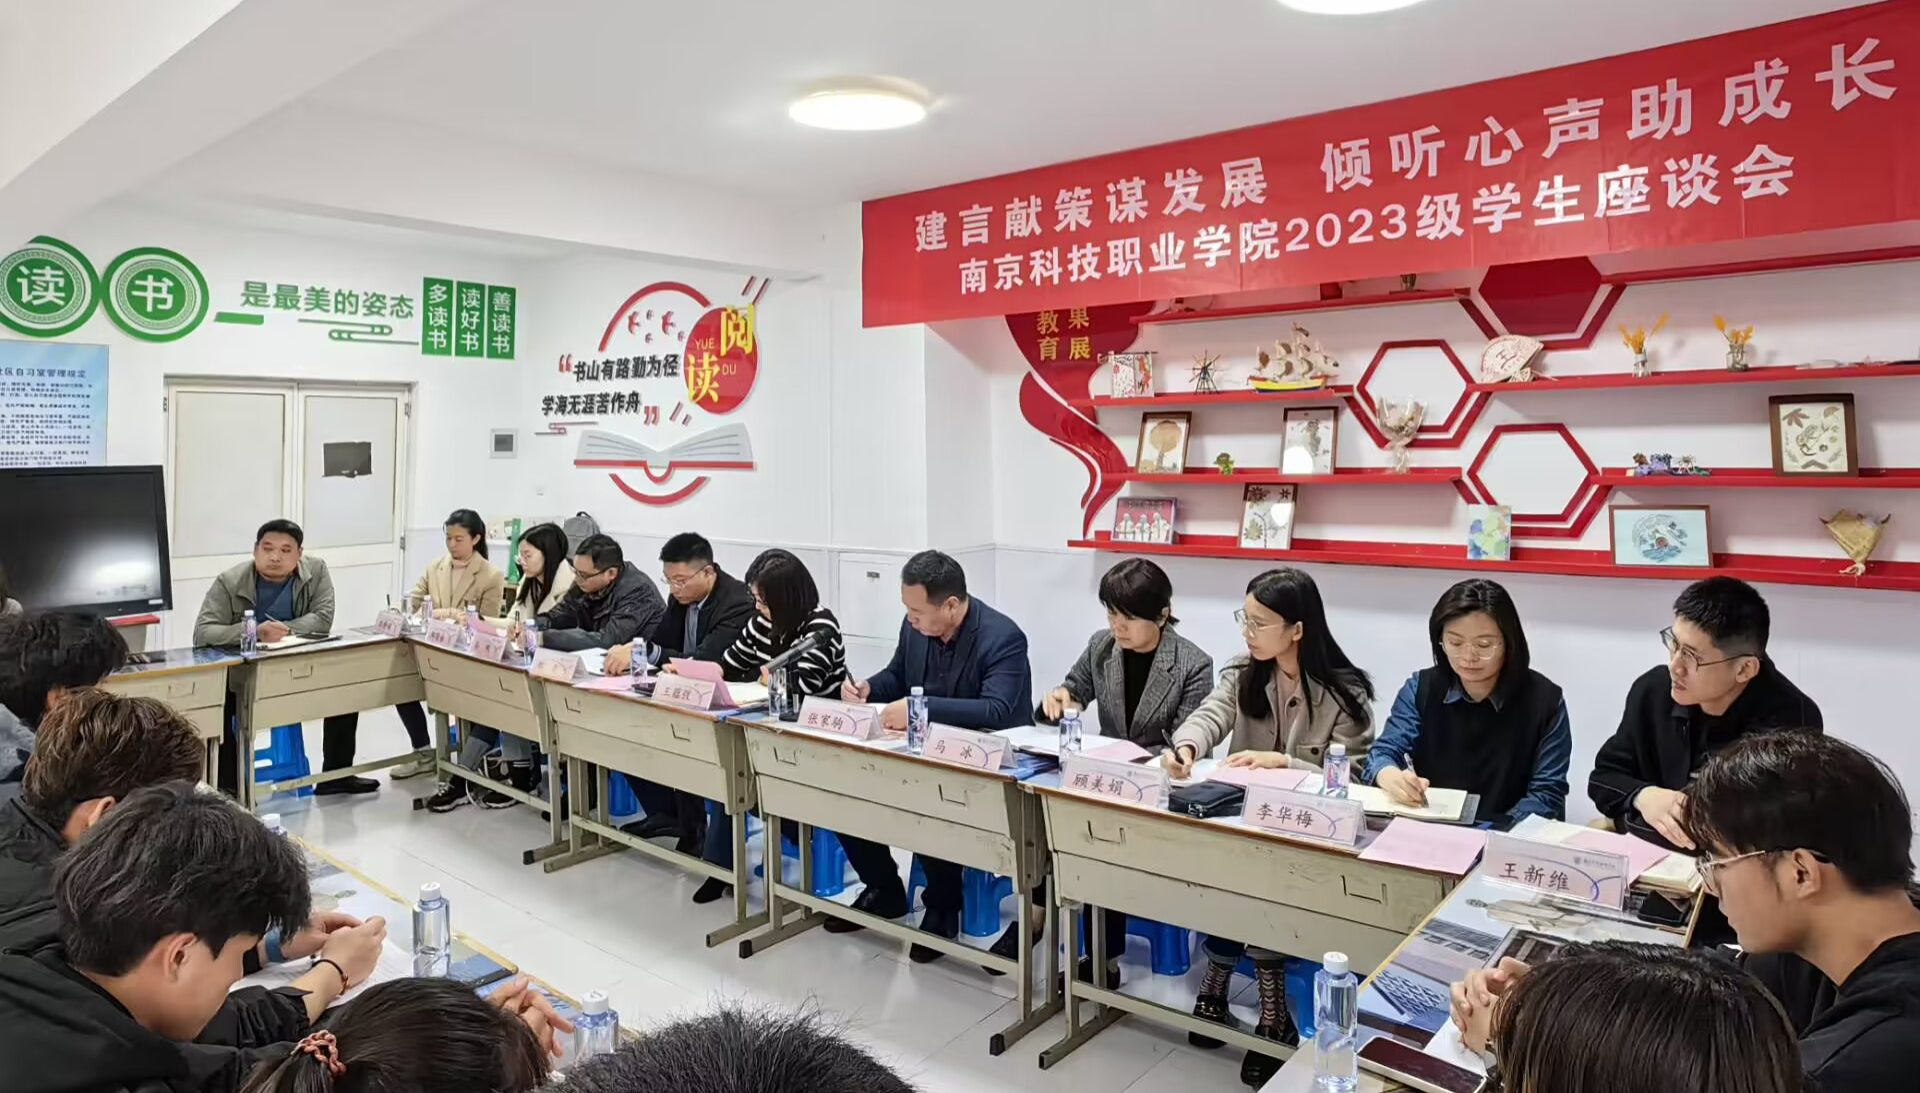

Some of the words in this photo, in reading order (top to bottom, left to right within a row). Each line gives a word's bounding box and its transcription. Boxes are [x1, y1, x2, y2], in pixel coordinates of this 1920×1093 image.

[915, 157, 1268, 253] 建言献策谋发展
[1320, 37, 1898, 192] 倾听心声助成长
[958, 144, 1795, 296] 南京科技职业学院2023级学生座谈会
[16, 265, 66, 306] 读
[131, 274, 174, 313] 书
[239, 281, 415, 319] 是最美的姿态
[426, 283, 449, 350] 多读书
[460, 287, 481, 352] 读好书
[492, 291, 511, 354] 善读书
[694, 337, 716, 350] YUE
[722, 363, 737, 376] DU
[1071, 773, 1124, 796] 顾美娟
[1255, 802, 1315, 829] 李华梅
[1497, 862, 1571, 891] 王新维
